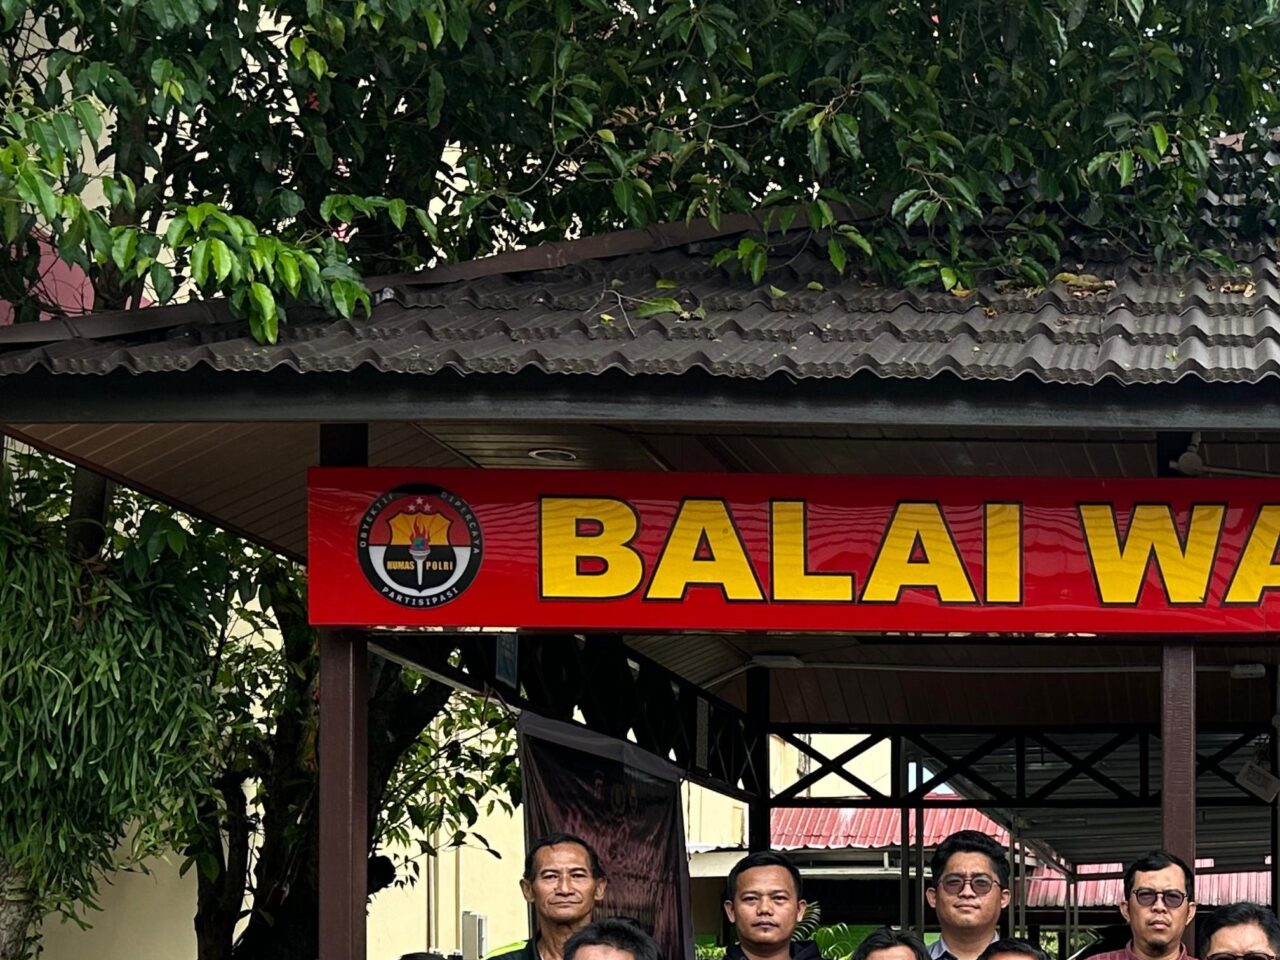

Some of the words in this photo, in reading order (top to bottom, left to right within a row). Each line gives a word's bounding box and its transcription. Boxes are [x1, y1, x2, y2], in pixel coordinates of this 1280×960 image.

[440, 491, 480, 554] DIPERCAYA
[386, 560, 415, 570] HUMAS
[425, 560, 454, 571] POLRI
[538, 494, 1024, 605] BALAI
[381, 586, 459, 606] PARTISIPASI
